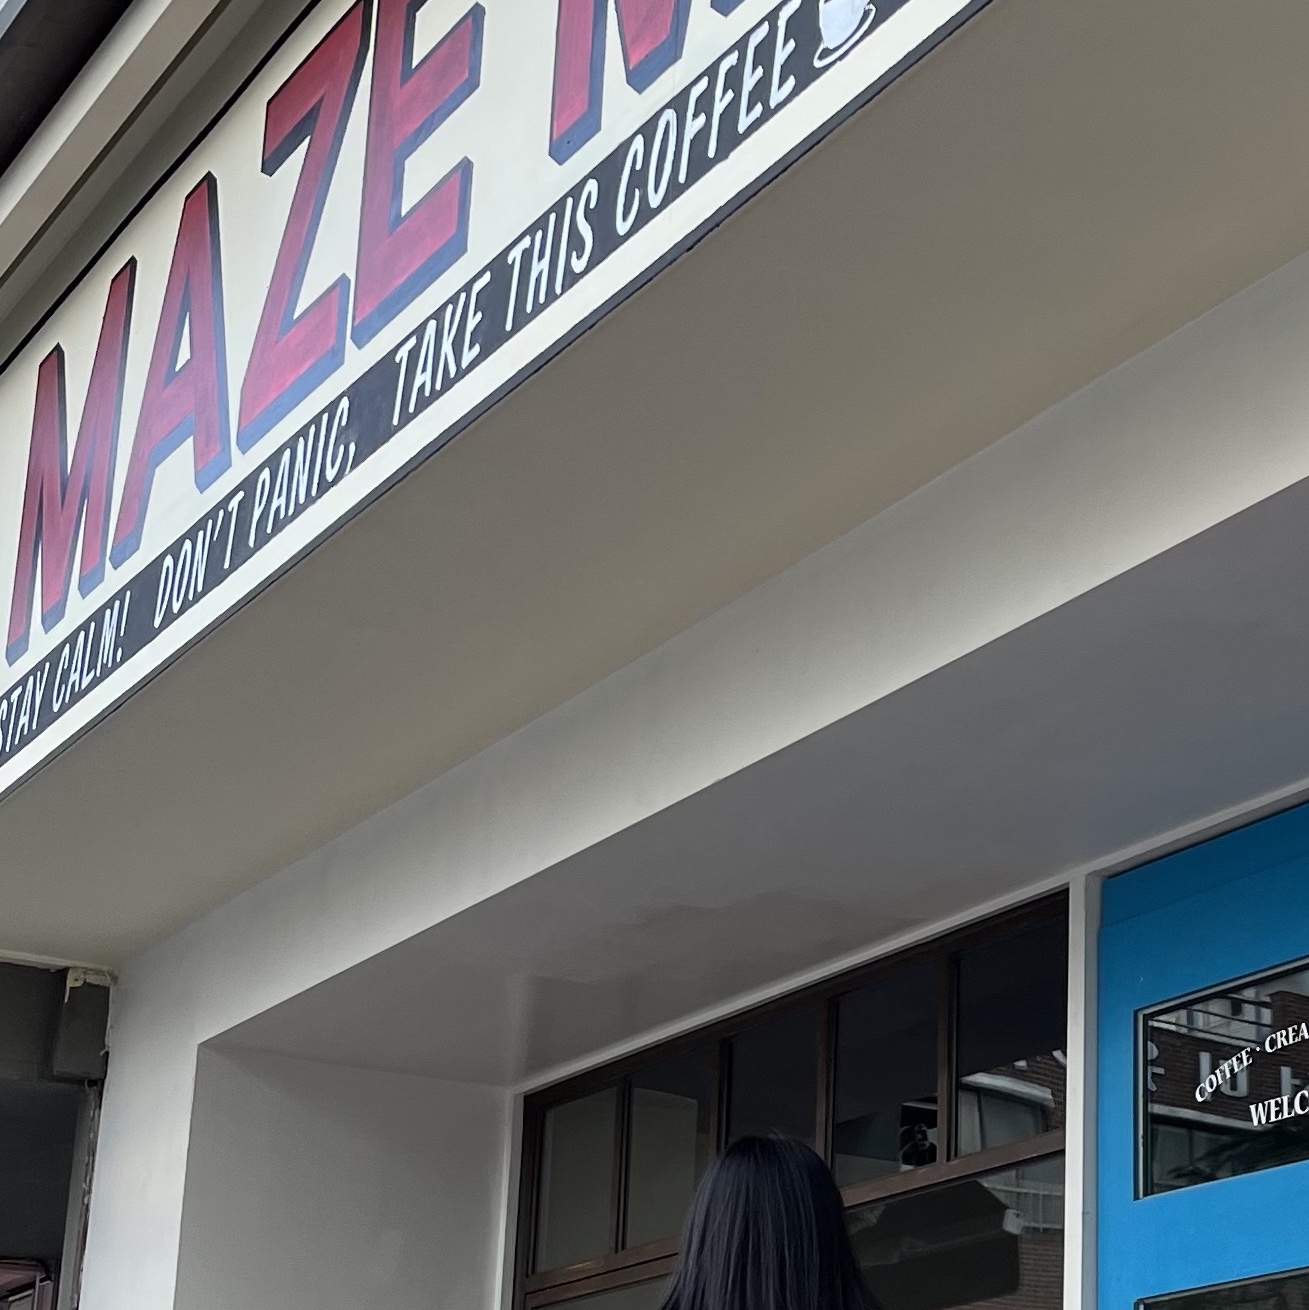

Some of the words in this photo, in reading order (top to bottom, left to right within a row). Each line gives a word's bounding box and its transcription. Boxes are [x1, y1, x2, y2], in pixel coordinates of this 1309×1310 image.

[53, 589, 131, 713] CALM!
[153, 490, 245, 629] DON'T
[249, 396, 356, 548] PANIC,
[392, 270, 491, 426] TAKE
[507, 178, 599, 332] THIS
[616, 0, 801, 236] COFFEE
[1195, 1046, 1253, 1102] COFFEE
